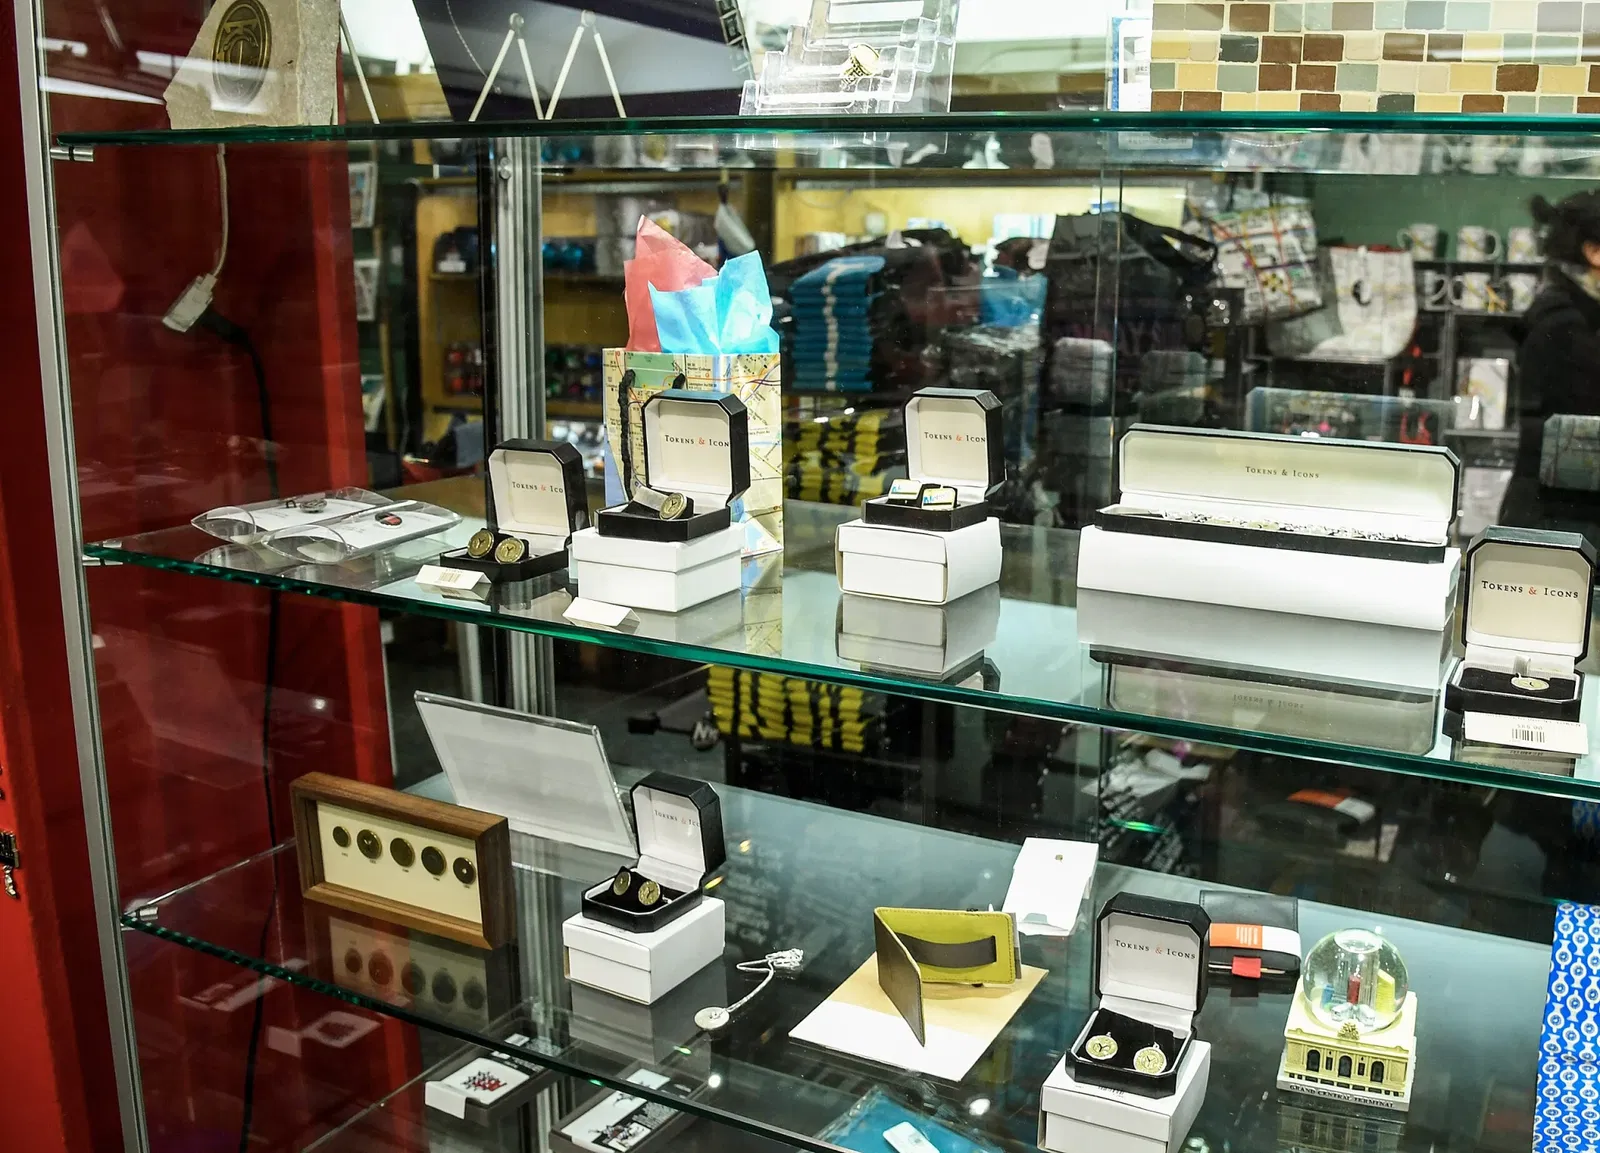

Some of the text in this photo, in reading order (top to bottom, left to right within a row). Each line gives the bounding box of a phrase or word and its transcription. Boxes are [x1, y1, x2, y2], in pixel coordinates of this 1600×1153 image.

[664, 434, 694, 445] TOKENS
[698, 436, 705, 445] &
[1293, 469, 1319, 479] ICONS
[1481, 580, 1579, 599] TOKENS & ICONS
[1114, 938, 1150, 952] TOKENS
[1167, 948, 1196, 960] ICONS
[1289, 1085, 1394, 1108] GRAND CENTRAL TERMINAL
